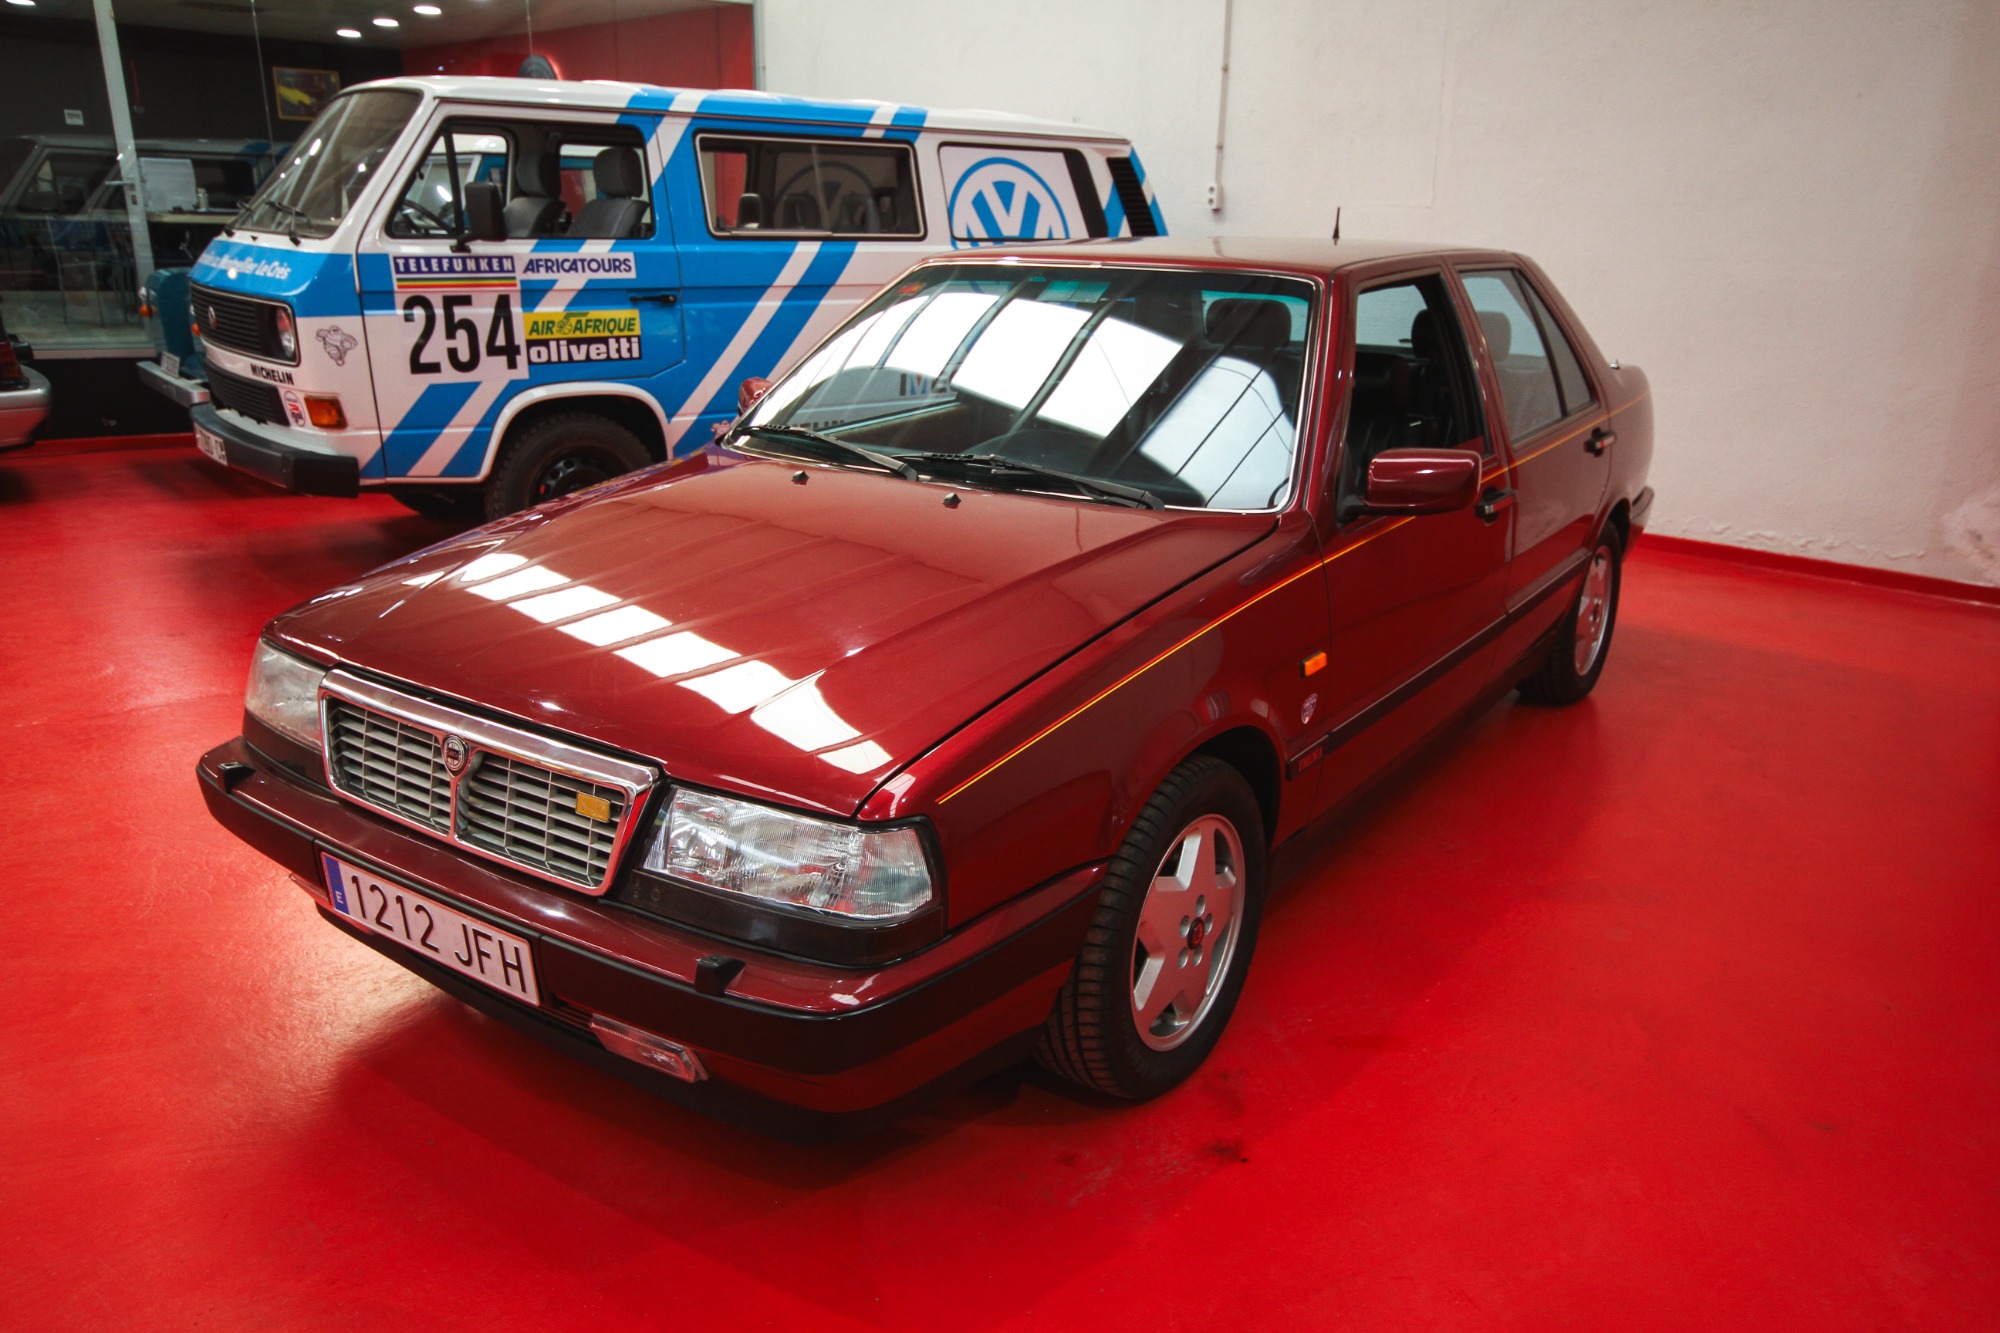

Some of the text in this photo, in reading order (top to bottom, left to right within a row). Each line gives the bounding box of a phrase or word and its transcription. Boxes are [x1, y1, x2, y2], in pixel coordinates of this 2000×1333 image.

[397, 256, 514, 272] TELEFUNKEN
[523, 258, 632, 274] AFRICATOURS
[403, 294, 520, 374] 254
[528, 317, 636, 335] AIR AFRIQUE
[529, 337, 640, 363] olivetti
[250, 364, 294, 386] MICHELIN
[335, 891, 342, 904] E
[351, 875, 527, 993] 1212 JFH
